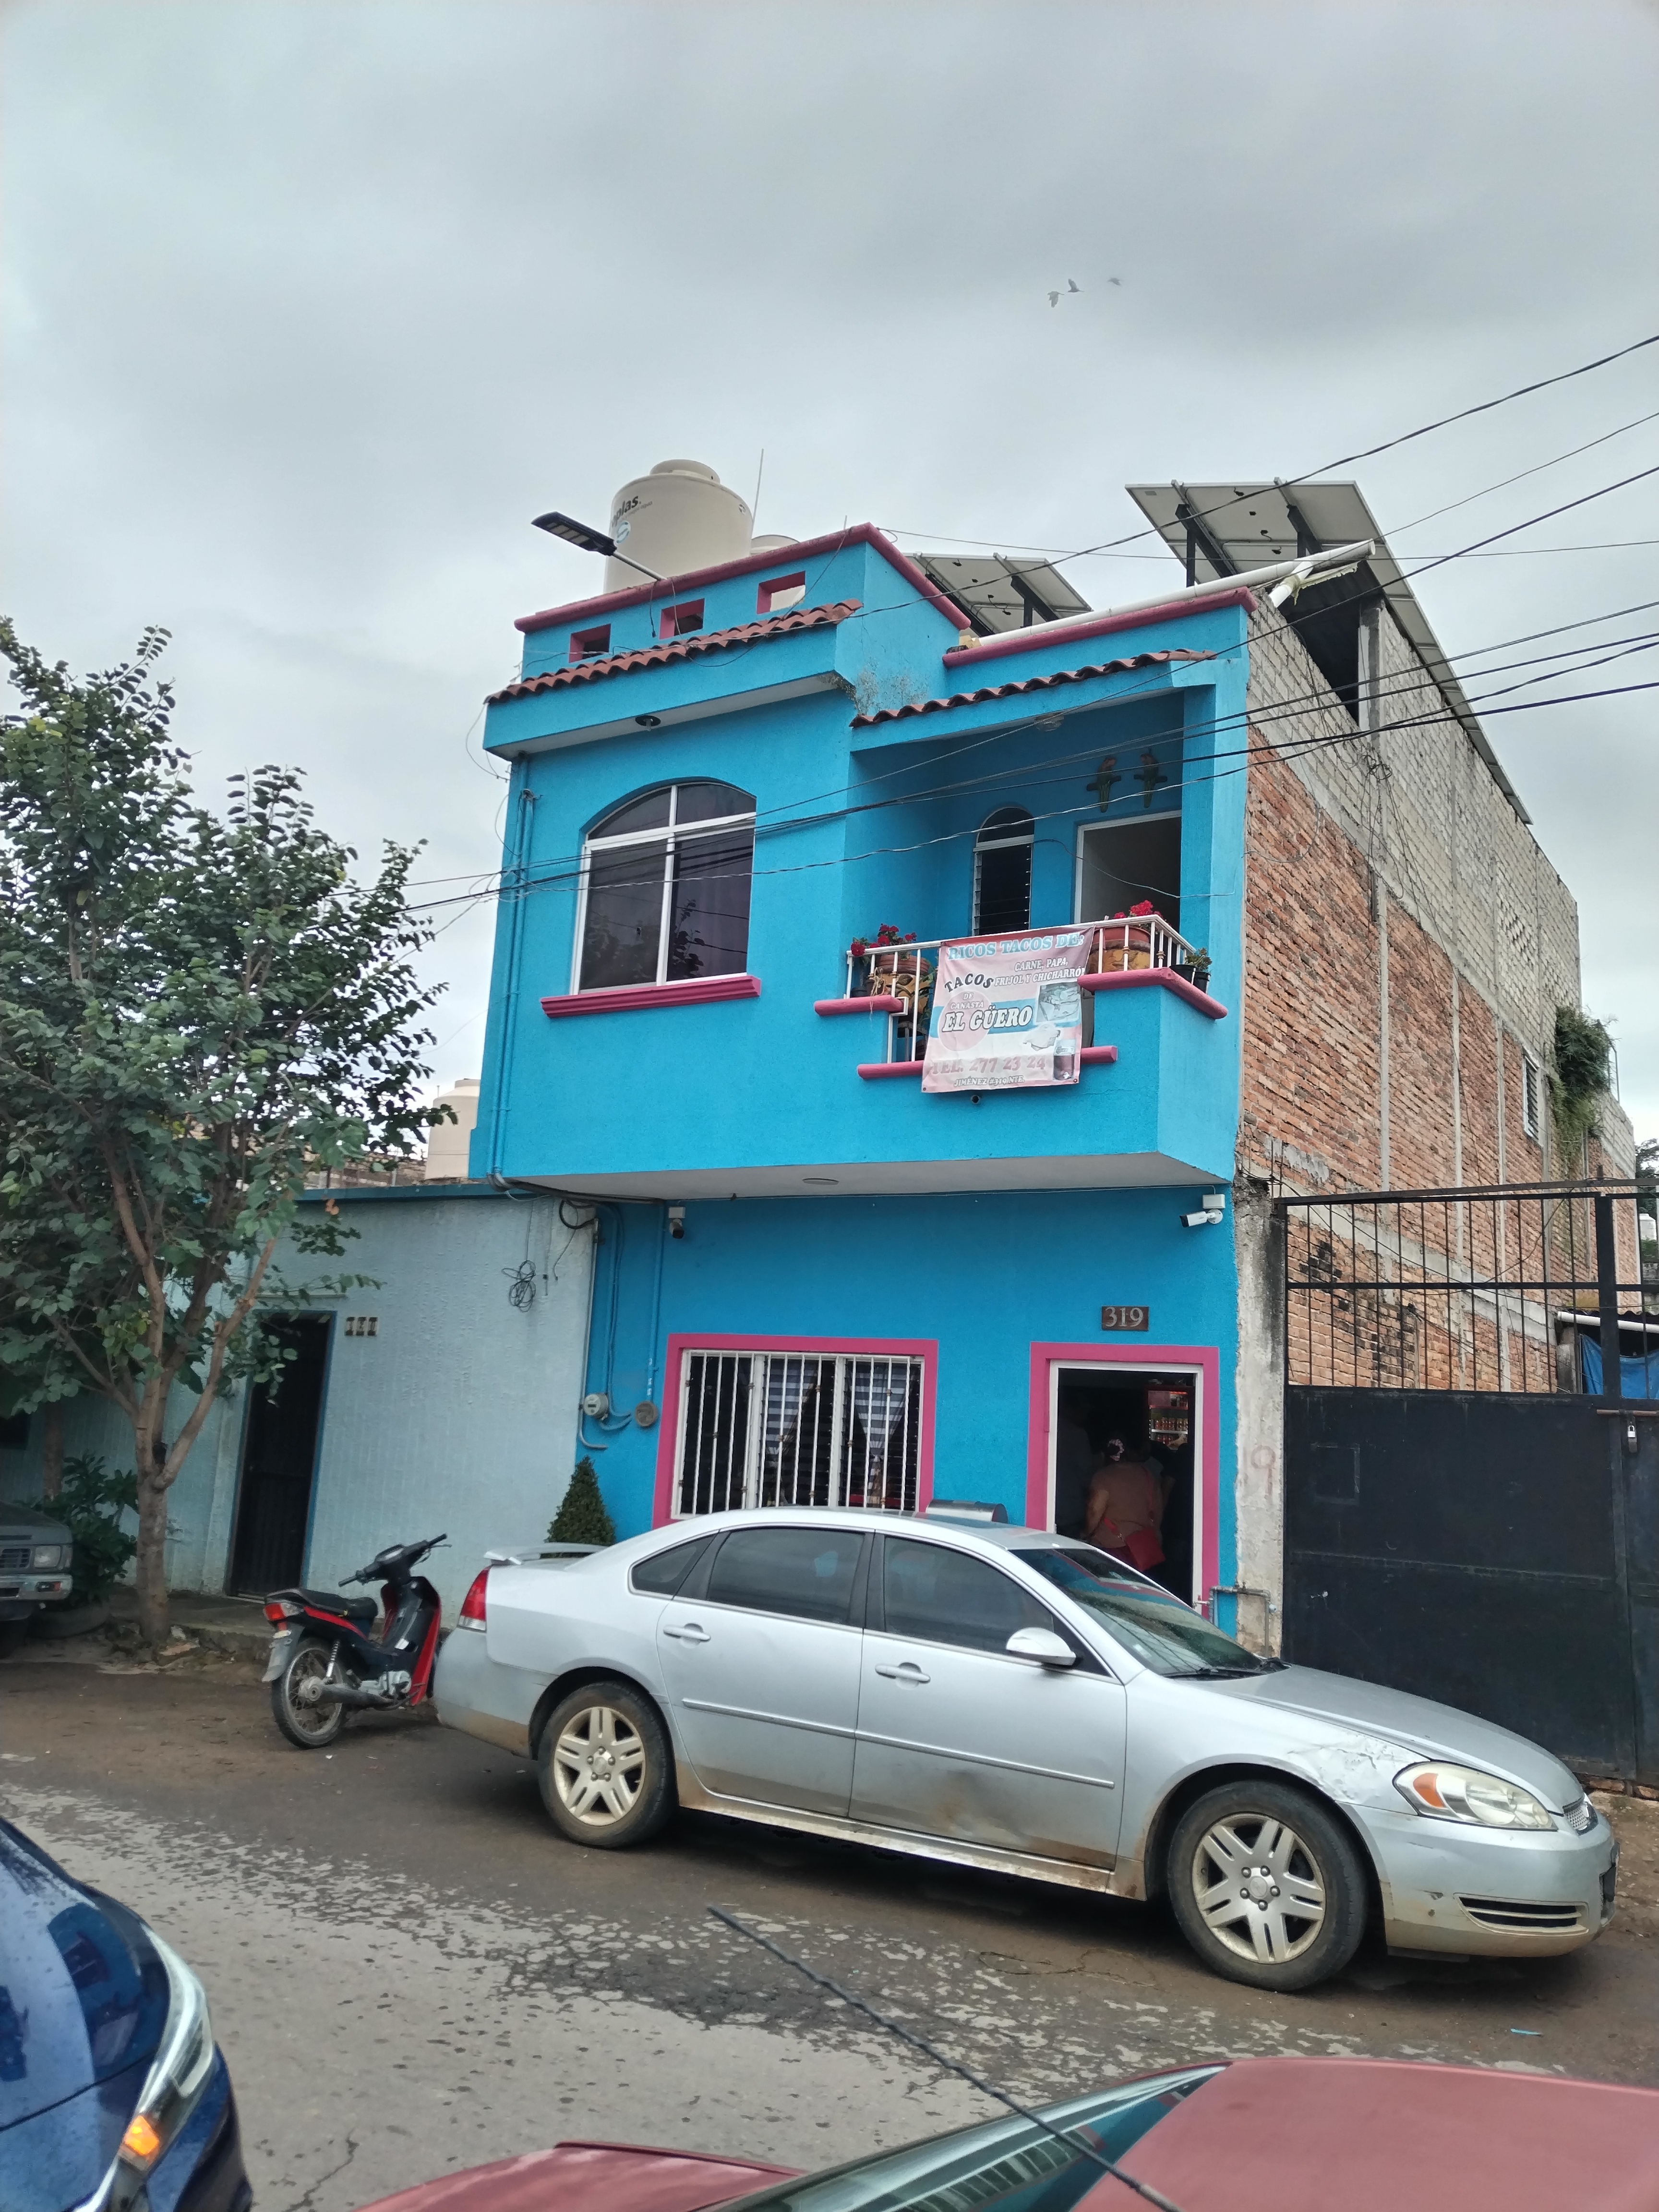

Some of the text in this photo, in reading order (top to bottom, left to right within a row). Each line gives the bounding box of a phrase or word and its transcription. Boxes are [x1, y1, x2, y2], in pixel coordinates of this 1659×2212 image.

[948, 932, 1084, 960] RICOS TACOS DE:
[1014, 957, 1068, 972] CARNE, PAPA,
[944, 974, 994, 992] TACOS
[994, 975, 1023, 986] FRIJOL
[1025, 974, 1032, 983] Y
[950, 1001, 984, 1010] CANASTA
[942, 1004, 1033, 1032] EL GÜERO
[931, 1055, 1046, 1074] TEL. 277 23 24
[953, 1075, 1025, 1087] JIMÉNEZ #319 NTE.
[1105, 1307, 1143, 1327] 319
